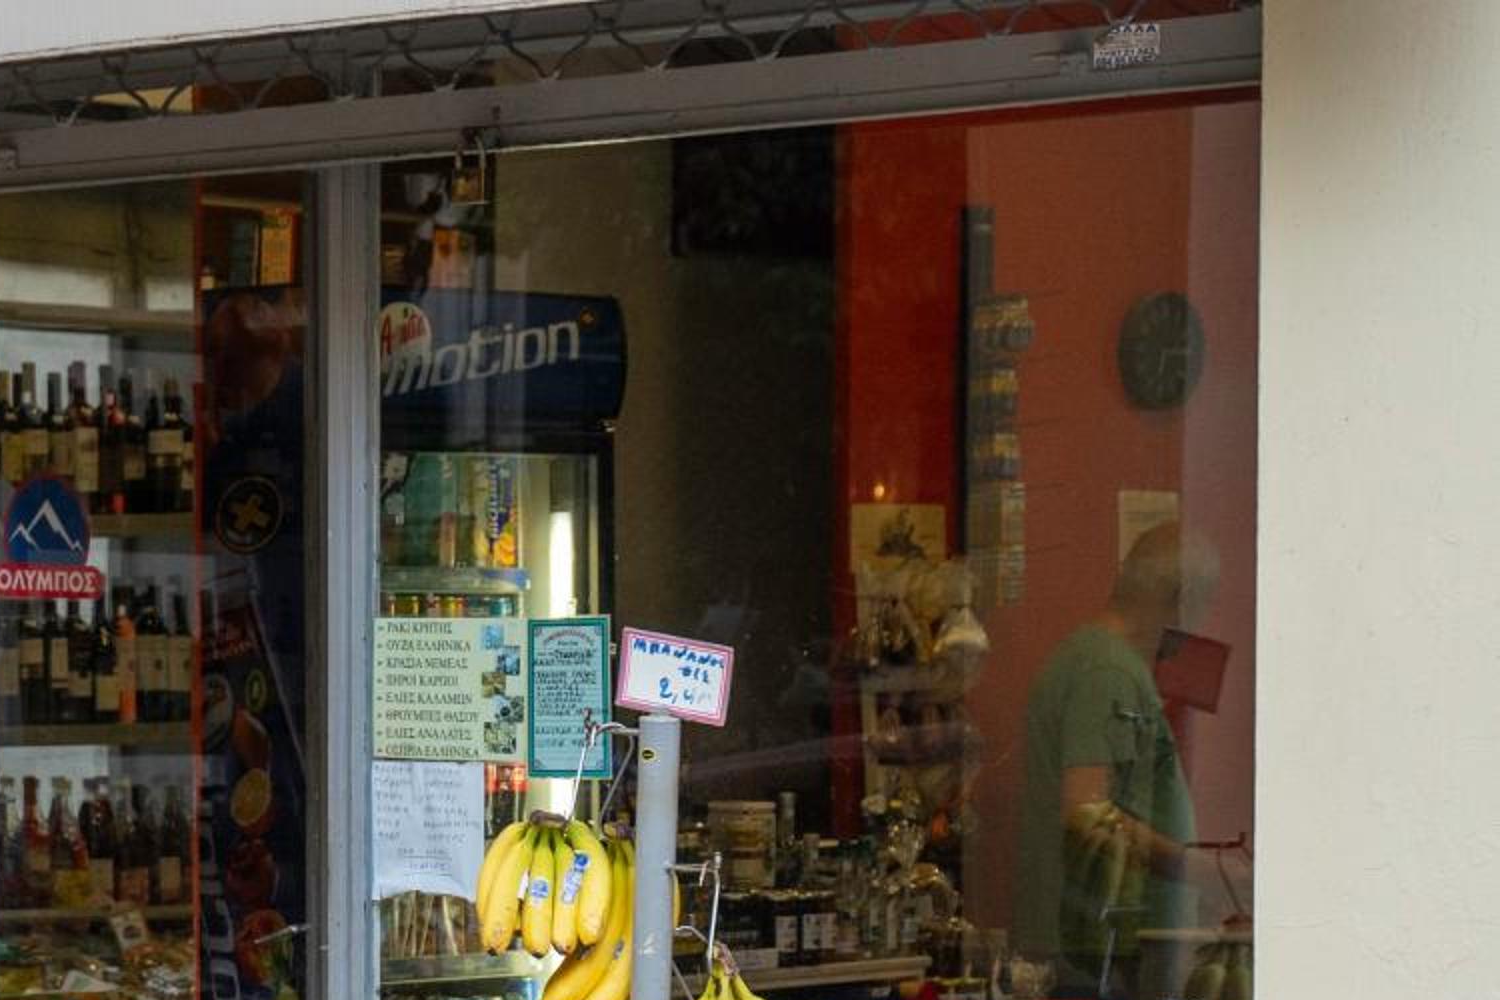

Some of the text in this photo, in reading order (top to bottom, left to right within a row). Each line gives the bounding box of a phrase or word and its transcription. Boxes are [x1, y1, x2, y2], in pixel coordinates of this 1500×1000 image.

[384, 319, 580, 396] motion
[416, 639, 471, 652] ΕΛΛΗΝΙΚΑ
[424, 657, 468, 669] ΝΕΜΕΑΣ
